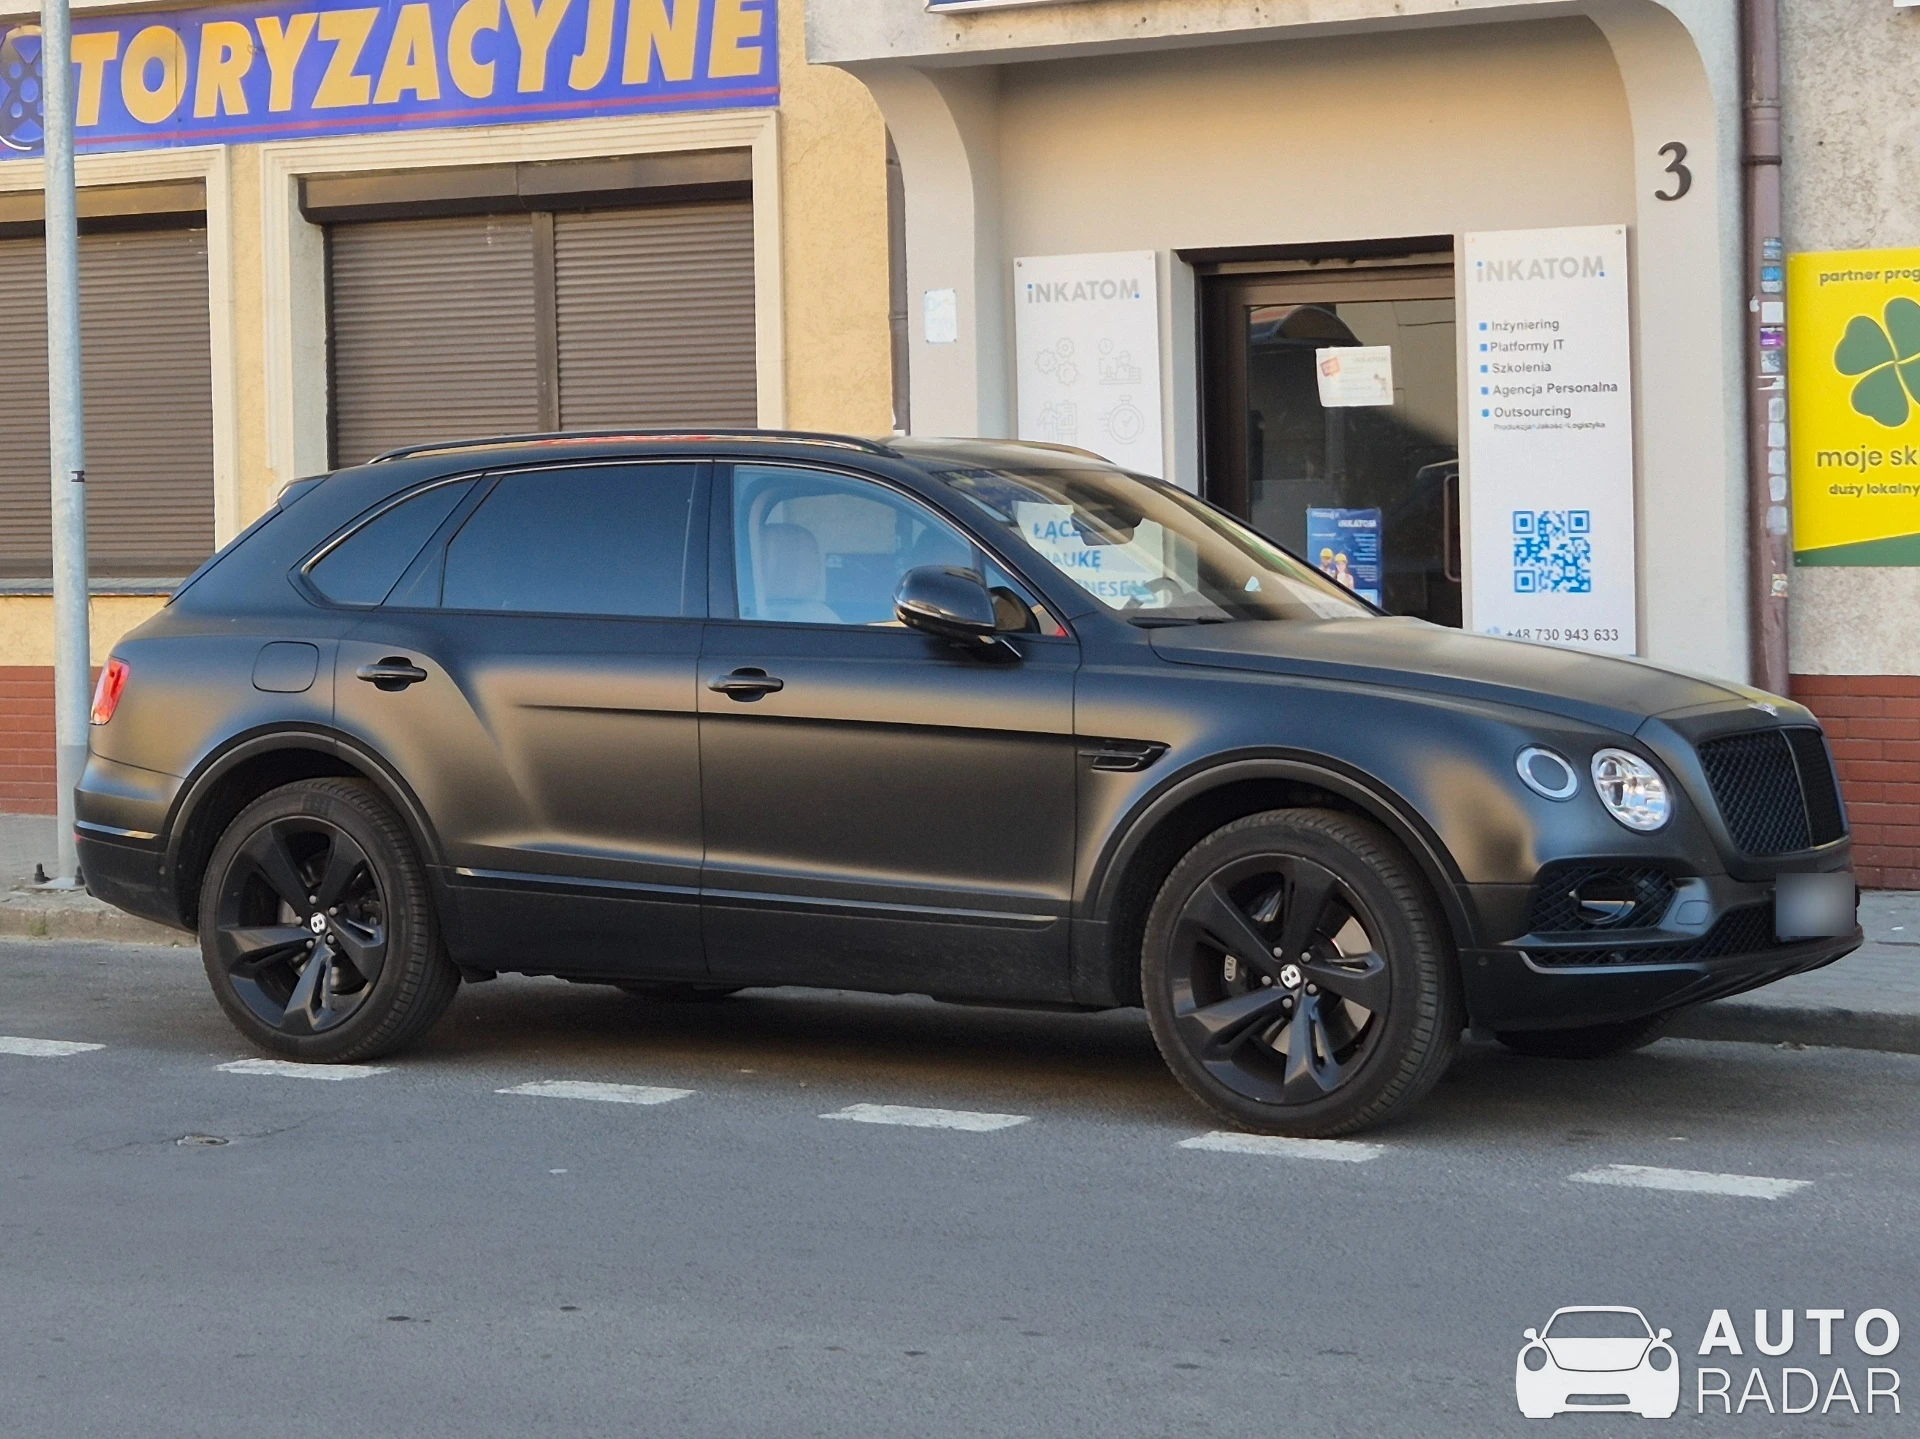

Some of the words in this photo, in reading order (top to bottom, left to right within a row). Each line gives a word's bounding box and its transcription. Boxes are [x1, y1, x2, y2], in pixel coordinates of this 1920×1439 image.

[1655, 141, 1692, 201] 3
[1819, 269, 1880, 287] partner
[1490, 340, 1550, 354] Platformy
[1553, 339, 1565, 351] IT
[1492, 362, 1552, 374] Szkolenia
[1492, 384, 1543, 398] Agencja
[1546, 382, 1618, 394] Personalna
[1494, 405, 1572, 419] Outsourcing
[1817, 444, 1883, 474] moje
[1829, 483, 1864, 498] duży
[1866, 482, 1920, 498] lokalny
[1046, 550, 1102, 572] AUKĘ
[1535, 628, 1560, 641] 730
[1564, 628, 1590, 641] 943
[1594, 628, 1619, 641] 633
